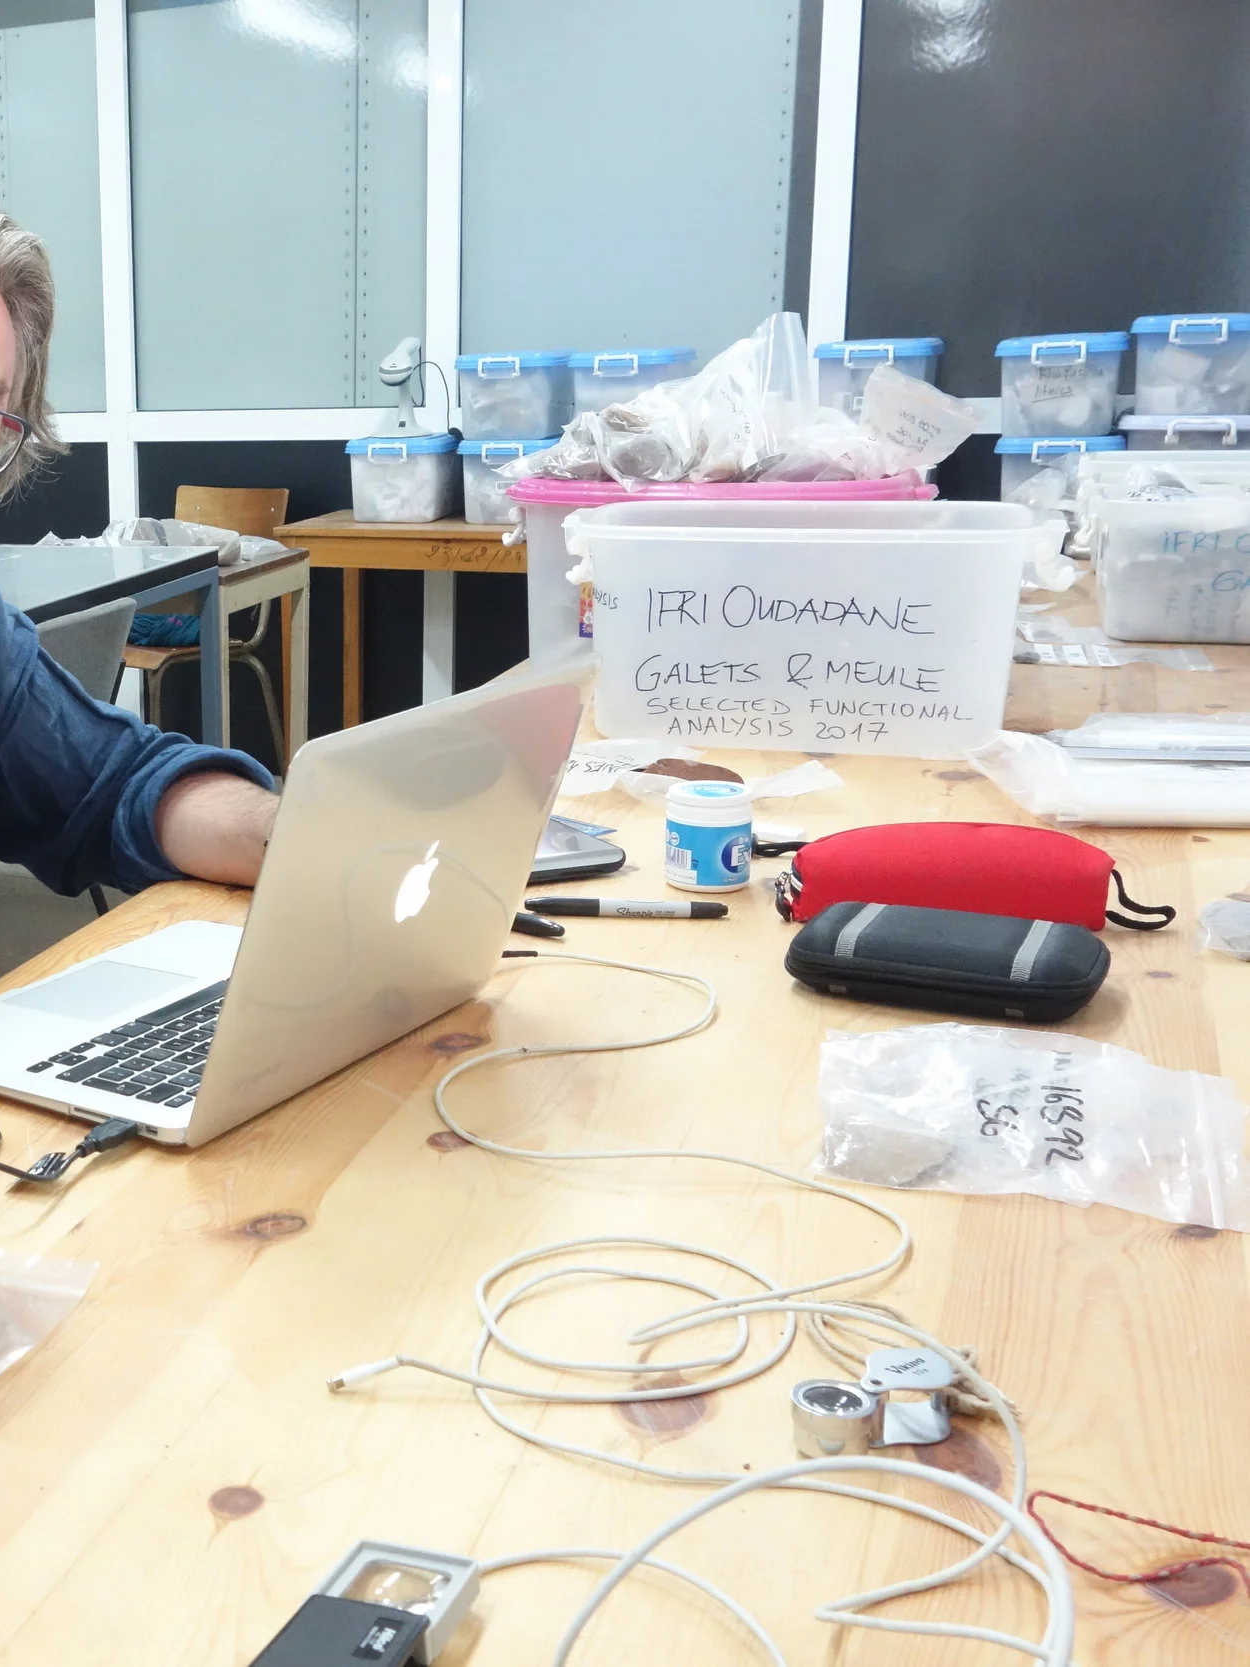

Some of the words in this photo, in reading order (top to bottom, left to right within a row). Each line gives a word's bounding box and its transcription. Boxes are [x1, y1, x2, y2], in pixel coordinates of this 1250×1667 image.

[648, 587, 707, 633] IFRI
[635, 653, 762, 692] GALETS
[786, 653, 813, 690] &
[826, 660, 947, 693] MEULE
[646, 696, 791, 715] SELECTED
[809, 698, 974, 721] FUNCTIONAL
[667, 716, 794, 737] ANALYSIS
[815, 721, 890, 743] 2017
[883, 1357, 926, 1375] Viking
